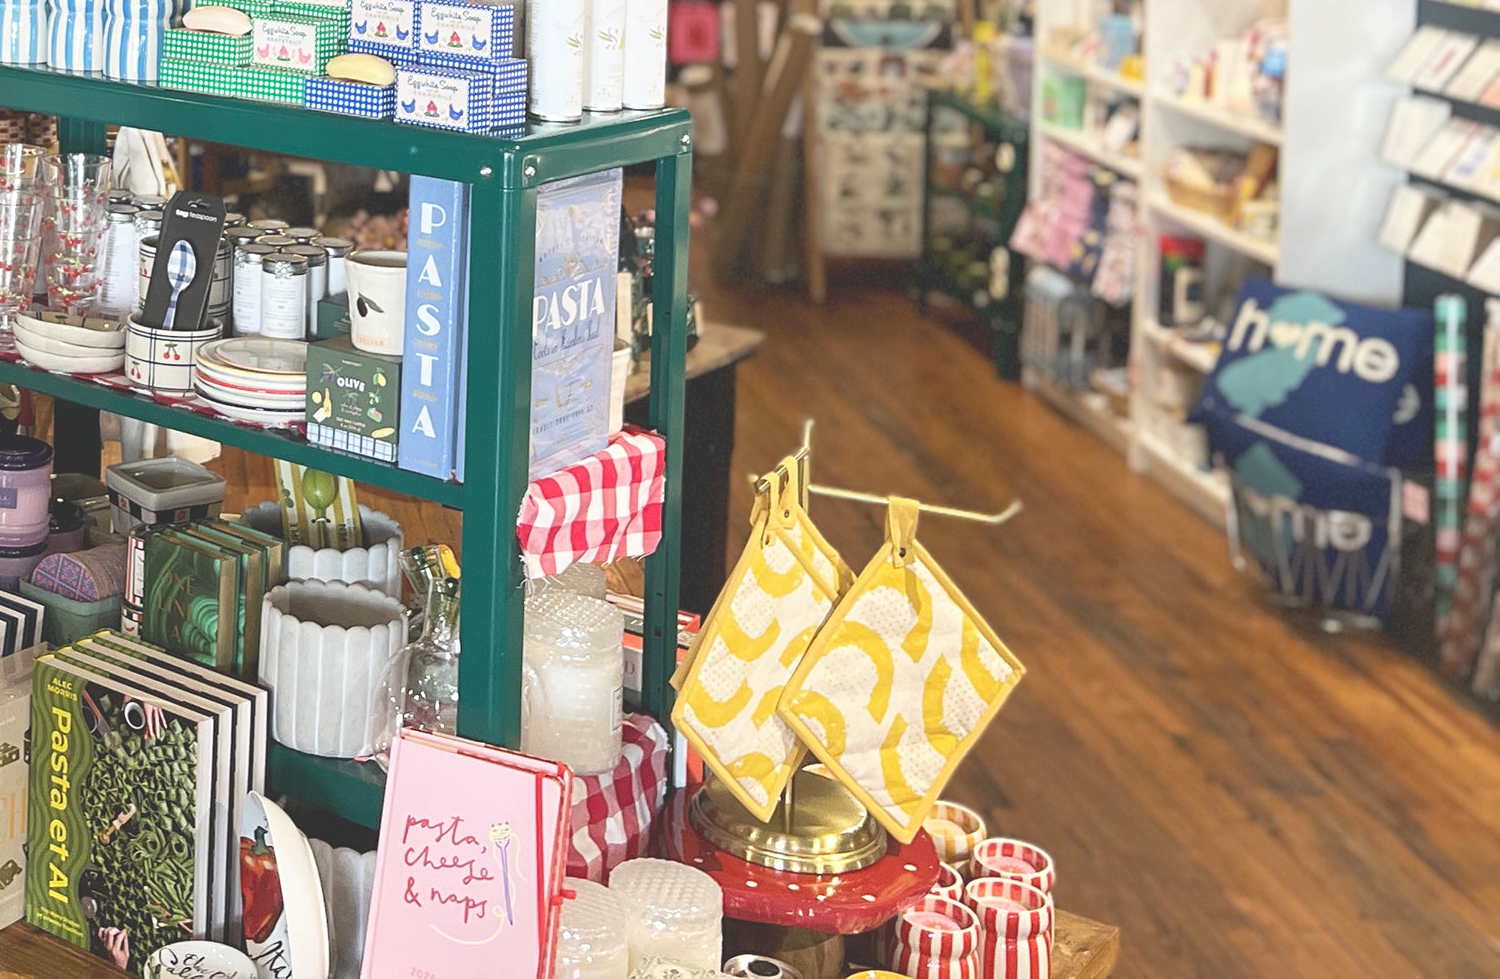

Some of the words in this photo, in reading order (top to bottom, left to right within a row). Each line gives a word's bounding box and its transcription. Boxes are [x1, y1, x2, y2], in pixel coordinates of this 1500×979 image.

[388, 1, 404, 15] Soap
[462, 10, 481, 24] Soap
[289, 26, 307, 38] Soap
[439, 80, 458, 94] Soap
[190, 212, 217, 222] teaspoon
[532, 277, 605, 338] PASTA
[412, 202, 446, 439] PASTA
[337, 377, 365, 392] OLIVE
[47, 684, 77, 702] MORRIS
[52, 677, 72, 691] ALEC
[50, 706, 72, 812] Pasta
[50, 819, 69, 862] et
[403, 814, 486, 854] pasta,
[49, 862, 68, 903] Al
[404, 876, 422, 907] &
[431, 887, 488, 923] naps
